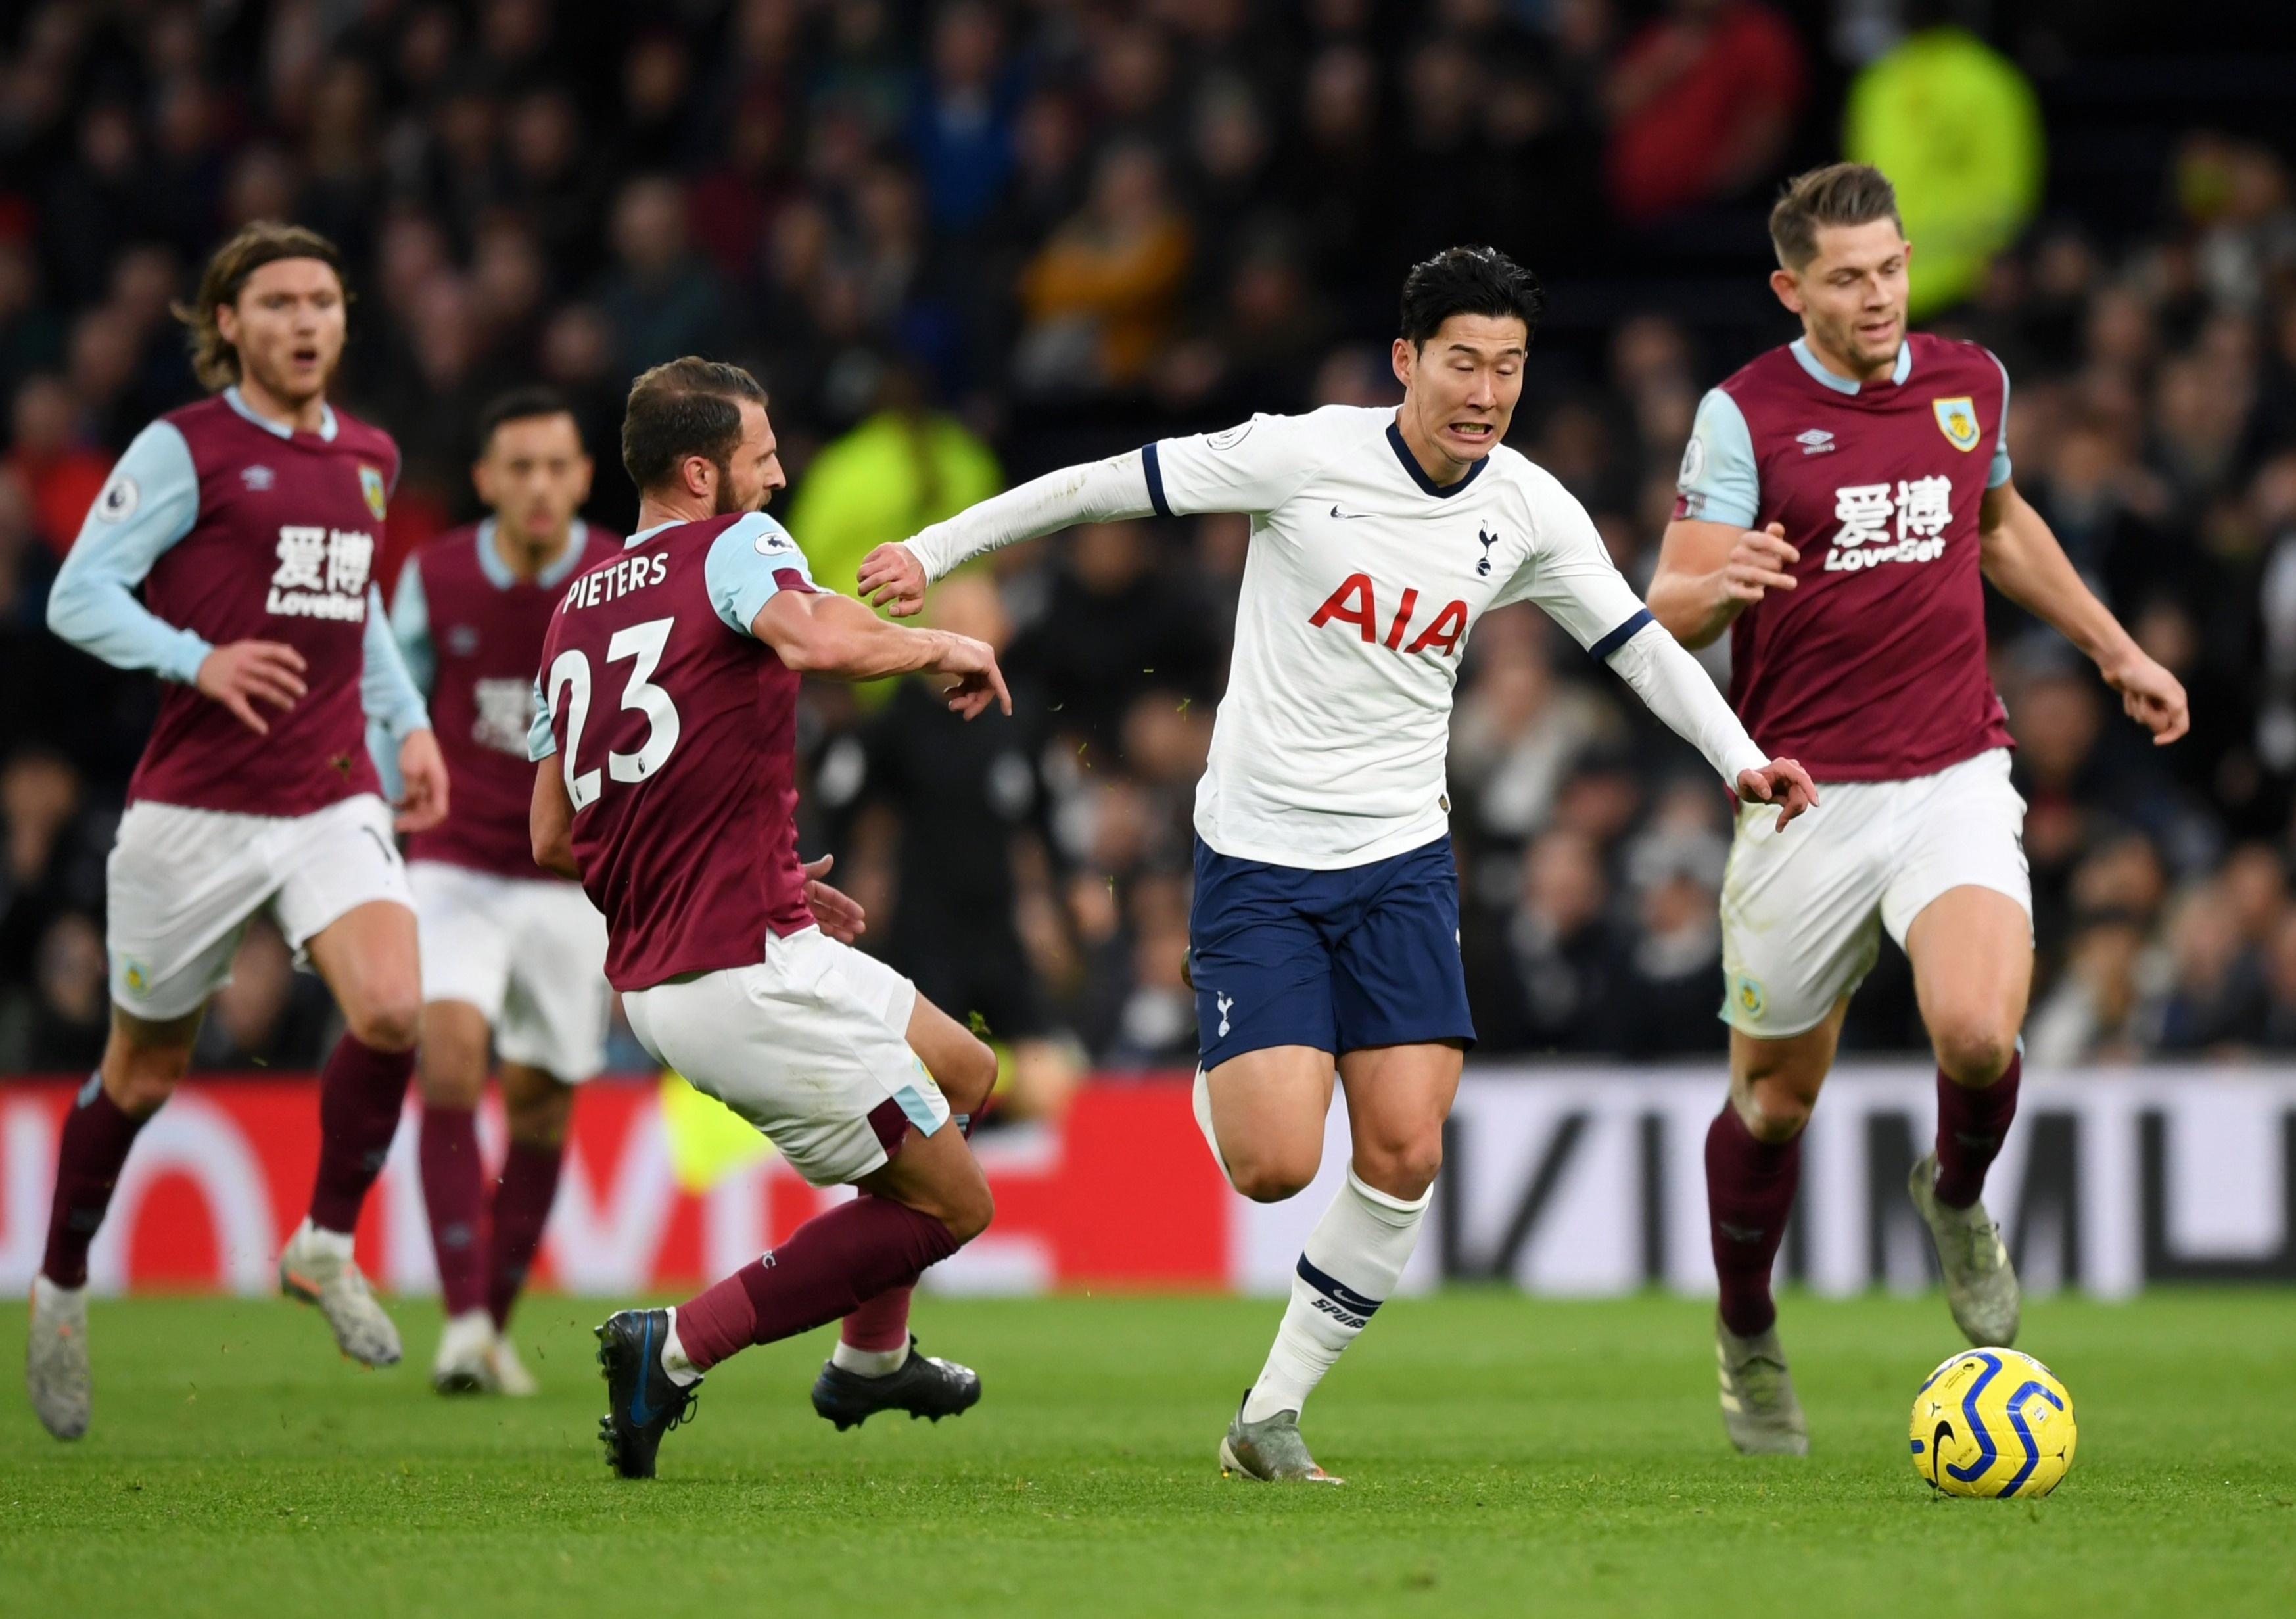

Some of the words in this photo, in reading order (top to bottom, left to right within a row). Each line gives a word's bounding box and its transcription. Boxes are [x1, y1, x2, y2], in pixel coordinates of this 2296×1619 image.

[1832, 475, 1953, 548] 爱博
[562, 553, 668, 614] PIETERS
[1308, 573, 1468, 657] AIA
[548, 616, 680, 813] 23
